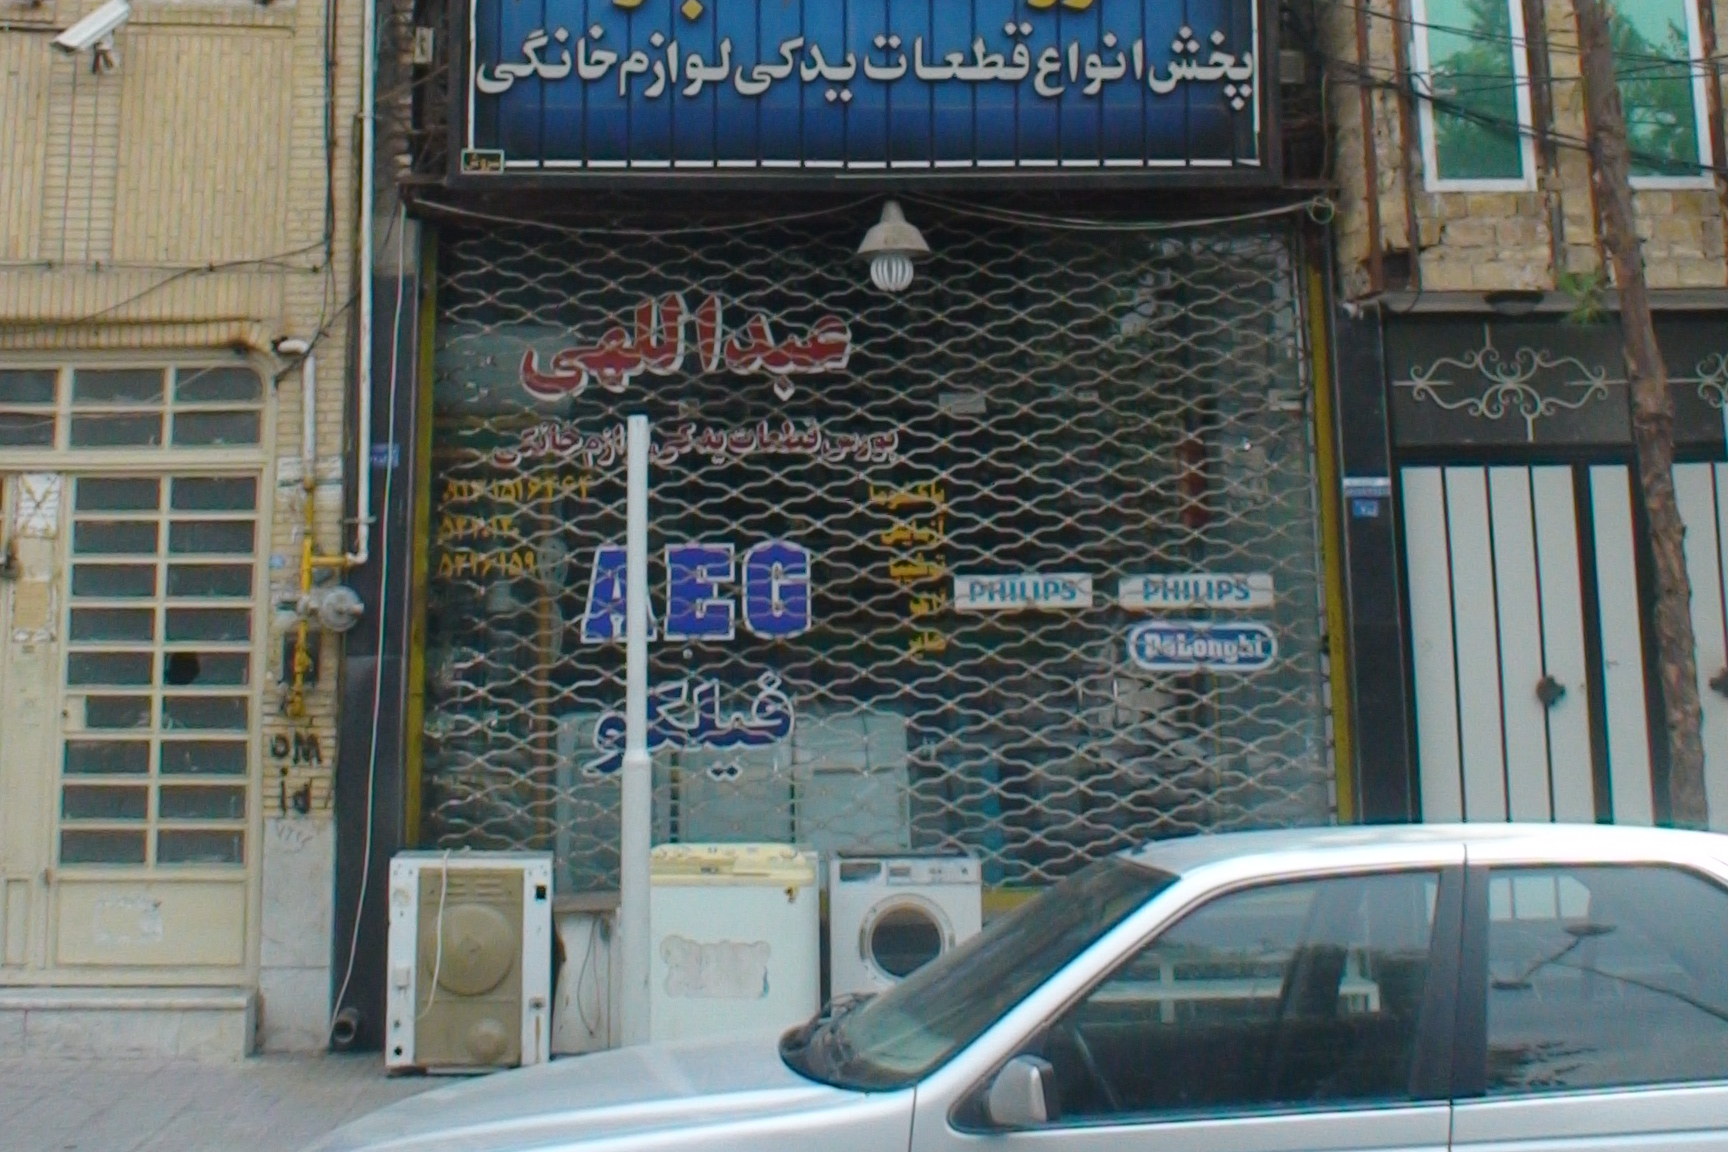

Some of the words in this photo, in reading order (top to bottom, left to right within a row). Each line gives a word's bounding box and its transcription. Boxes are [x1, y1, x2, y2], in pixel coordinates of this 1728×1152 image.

[476, 24, 618, 94] خانگی
[618, 31, 733, 98] لوازم
[734, 37, 857, 103] یدکی
[863, 21, 1031, 81] قطعات
[1034, 32, 1143, 97] انواع
[1148, 25, 1254, 111] پخش
[580, 539, 812, 644] AEG
[968, 579, 1078, 604] PHILIPS
[1142, 576, 1251, 602] PHILIPS
[1143, 631, 1266, 663] DeLonghi
